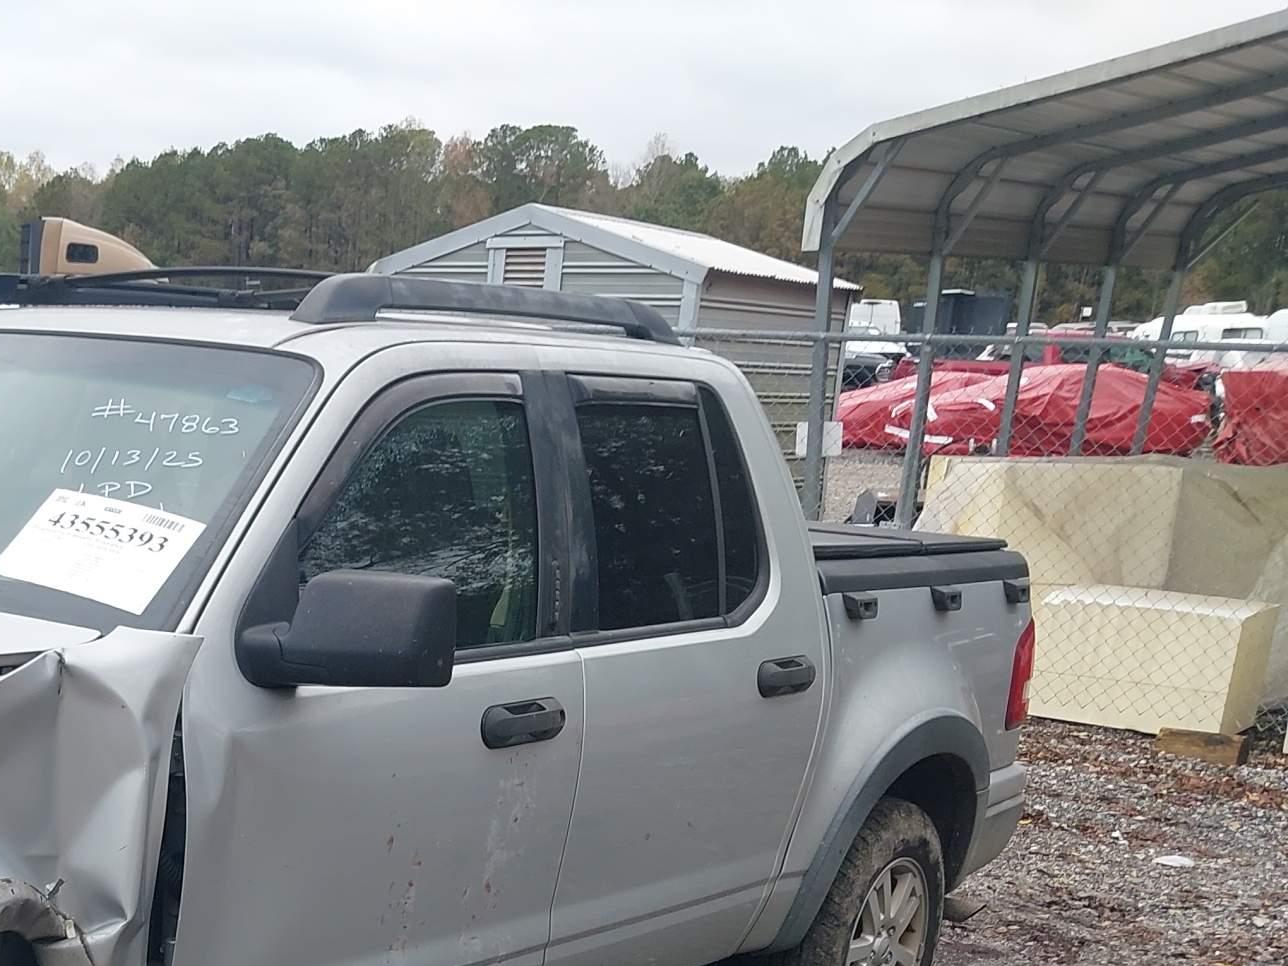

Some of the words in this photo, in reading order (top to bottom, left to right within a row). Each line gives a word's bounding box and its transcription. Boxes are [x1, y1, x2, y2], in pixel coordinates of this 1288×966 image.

[91, 398, 240, 434] #47863
[60, 447, 204, 474] 10/13/25
[47, 511, 169, 553] 43555393
